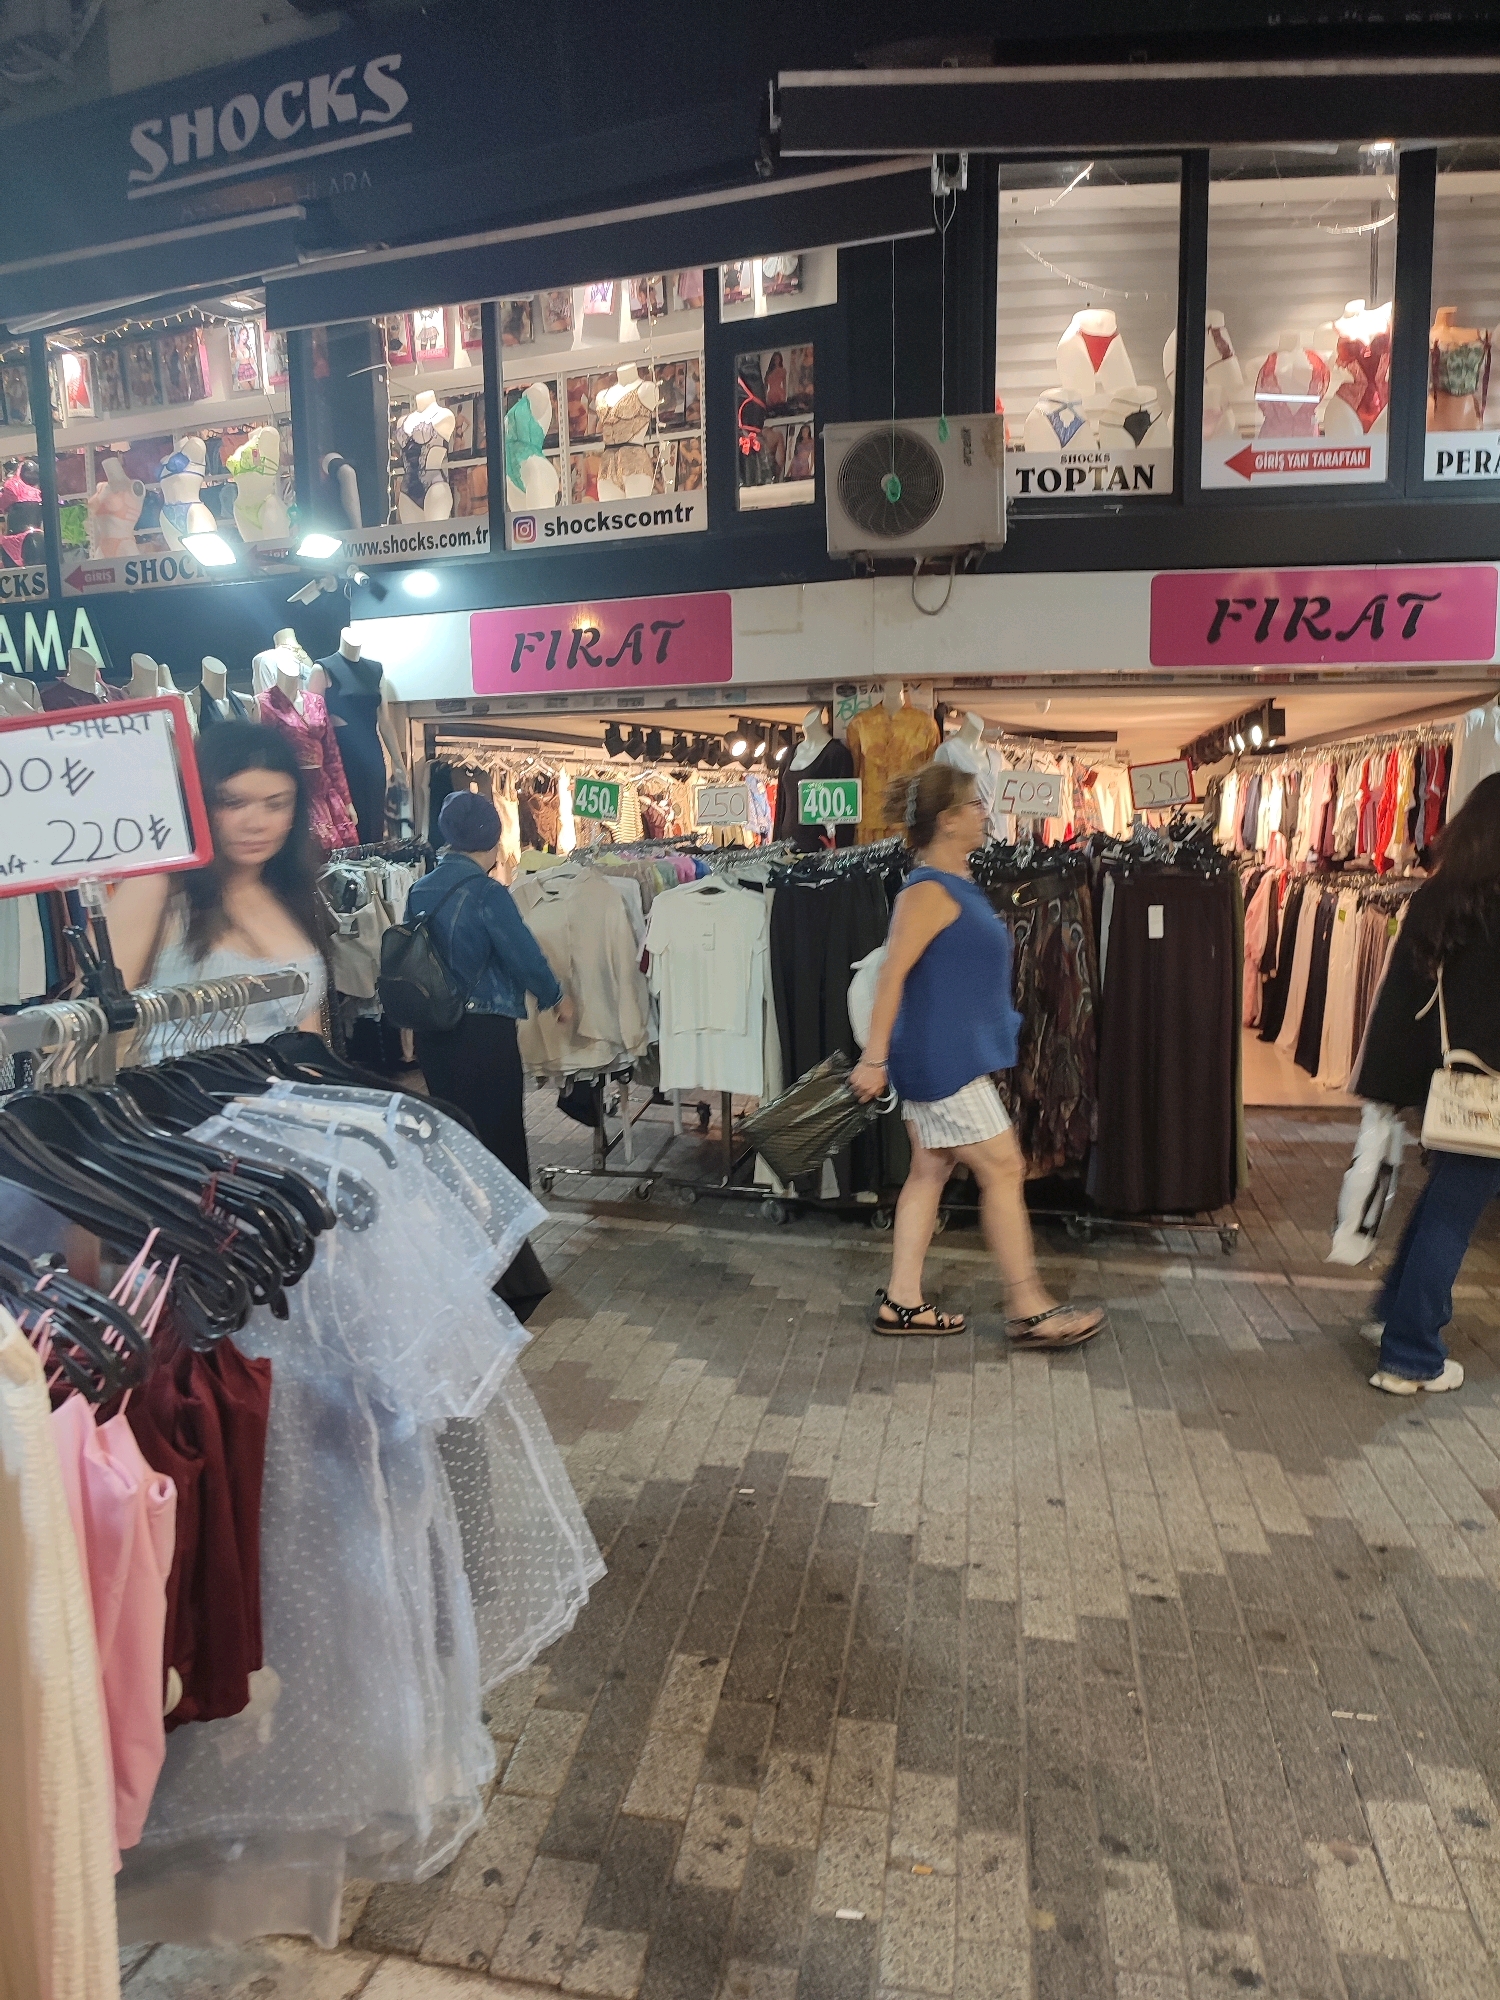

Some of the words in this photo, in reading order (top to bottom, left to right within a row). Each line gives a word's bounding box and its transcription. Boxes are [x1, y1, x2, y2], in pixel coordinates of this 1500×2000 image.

[128, 54, 409, 183] SHOCKS
[1060, 453, 1111, 464] SHOCKS
[1287, 452, 1309, 468] YAN
[1312, 449, 1366, 468] TARAFTAN
[1015, 464, 1156, 493] TOPTAN
[544, 502, 694, 537] shockscomtr
[343, 525, 489, 558] www.shocks.com.tr
[1206, 592, 1442, 644] FIRAT
[510, 619, 685, 673] FIRAT
[1139, 767, 1191, 804] 350
[699, 791, 745, 818] 250
